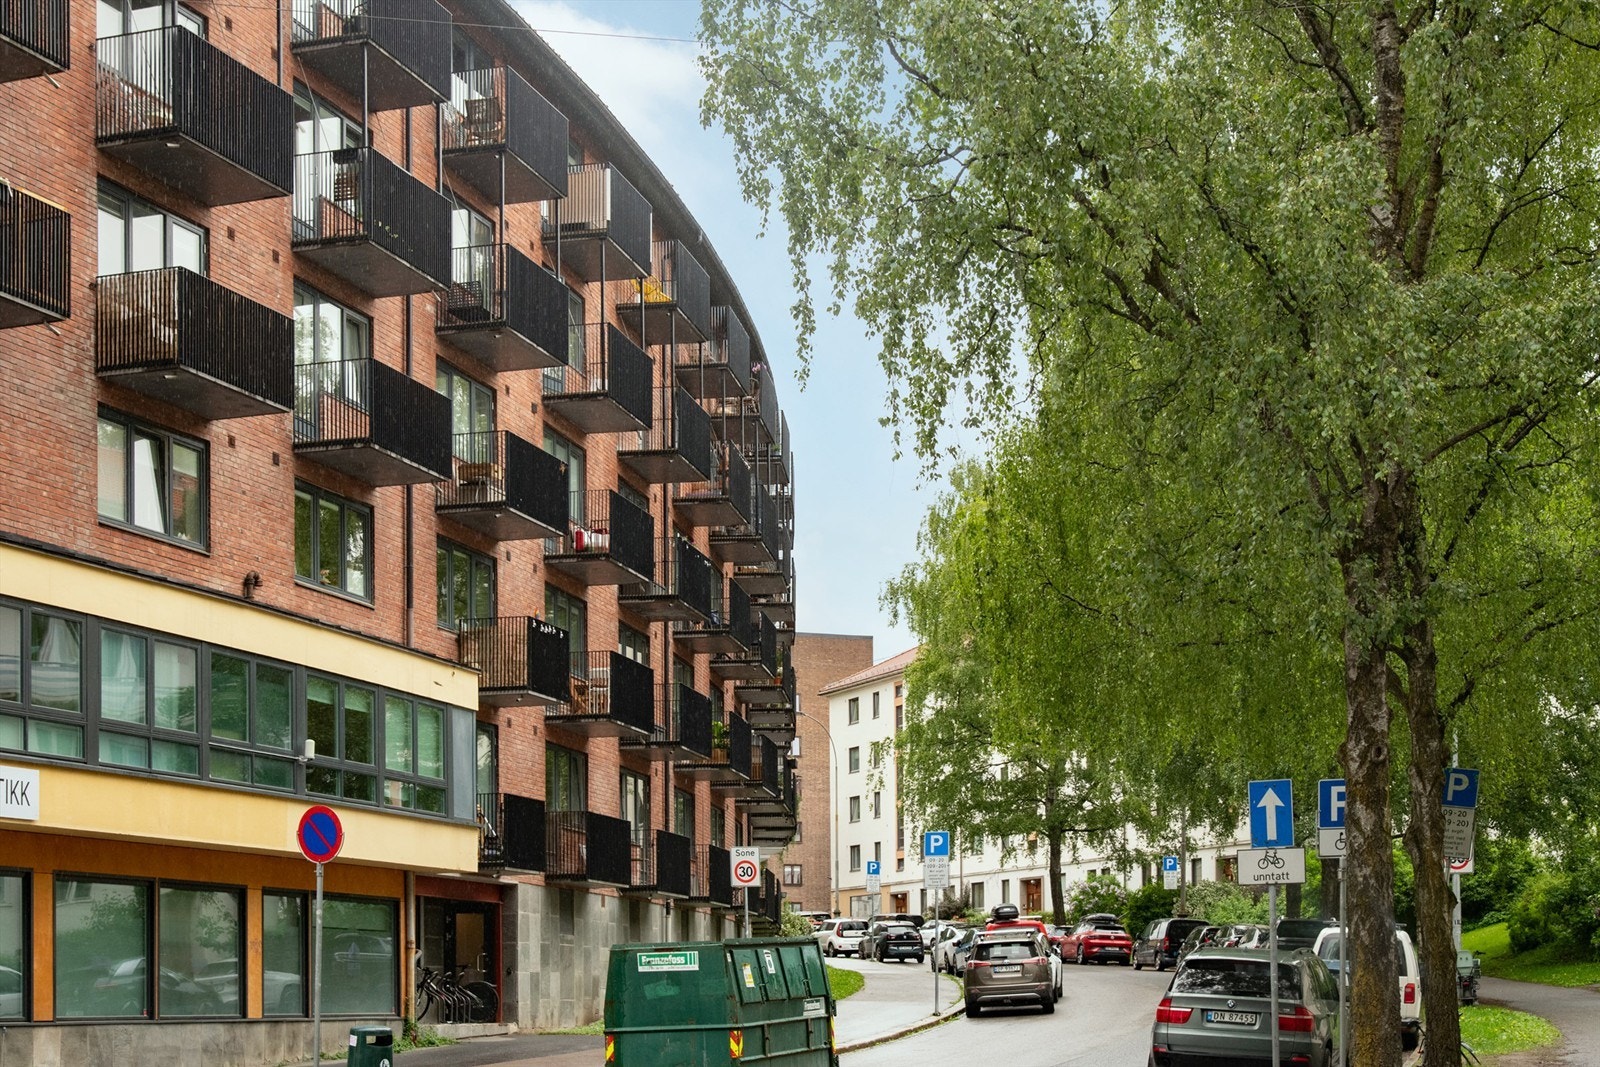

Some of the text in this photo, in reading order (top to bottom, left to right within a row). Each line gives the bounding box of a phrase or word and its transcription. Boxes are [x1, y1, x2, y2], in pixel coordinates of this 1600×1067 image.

[0, 778, 30, 806] IKK
[1447, 773, 1469, 801] P
[930, 835, 943, 853] P
[735, 849, 755, 857] Sone
[870, 863, 877, 873] P
[1166, 858, 1174, 869] P
[738, 866, 753, 877] 30
[1253, 872, 1290, 881] unntatt
[1213, 1011, 1254, 1022] DN 87455
